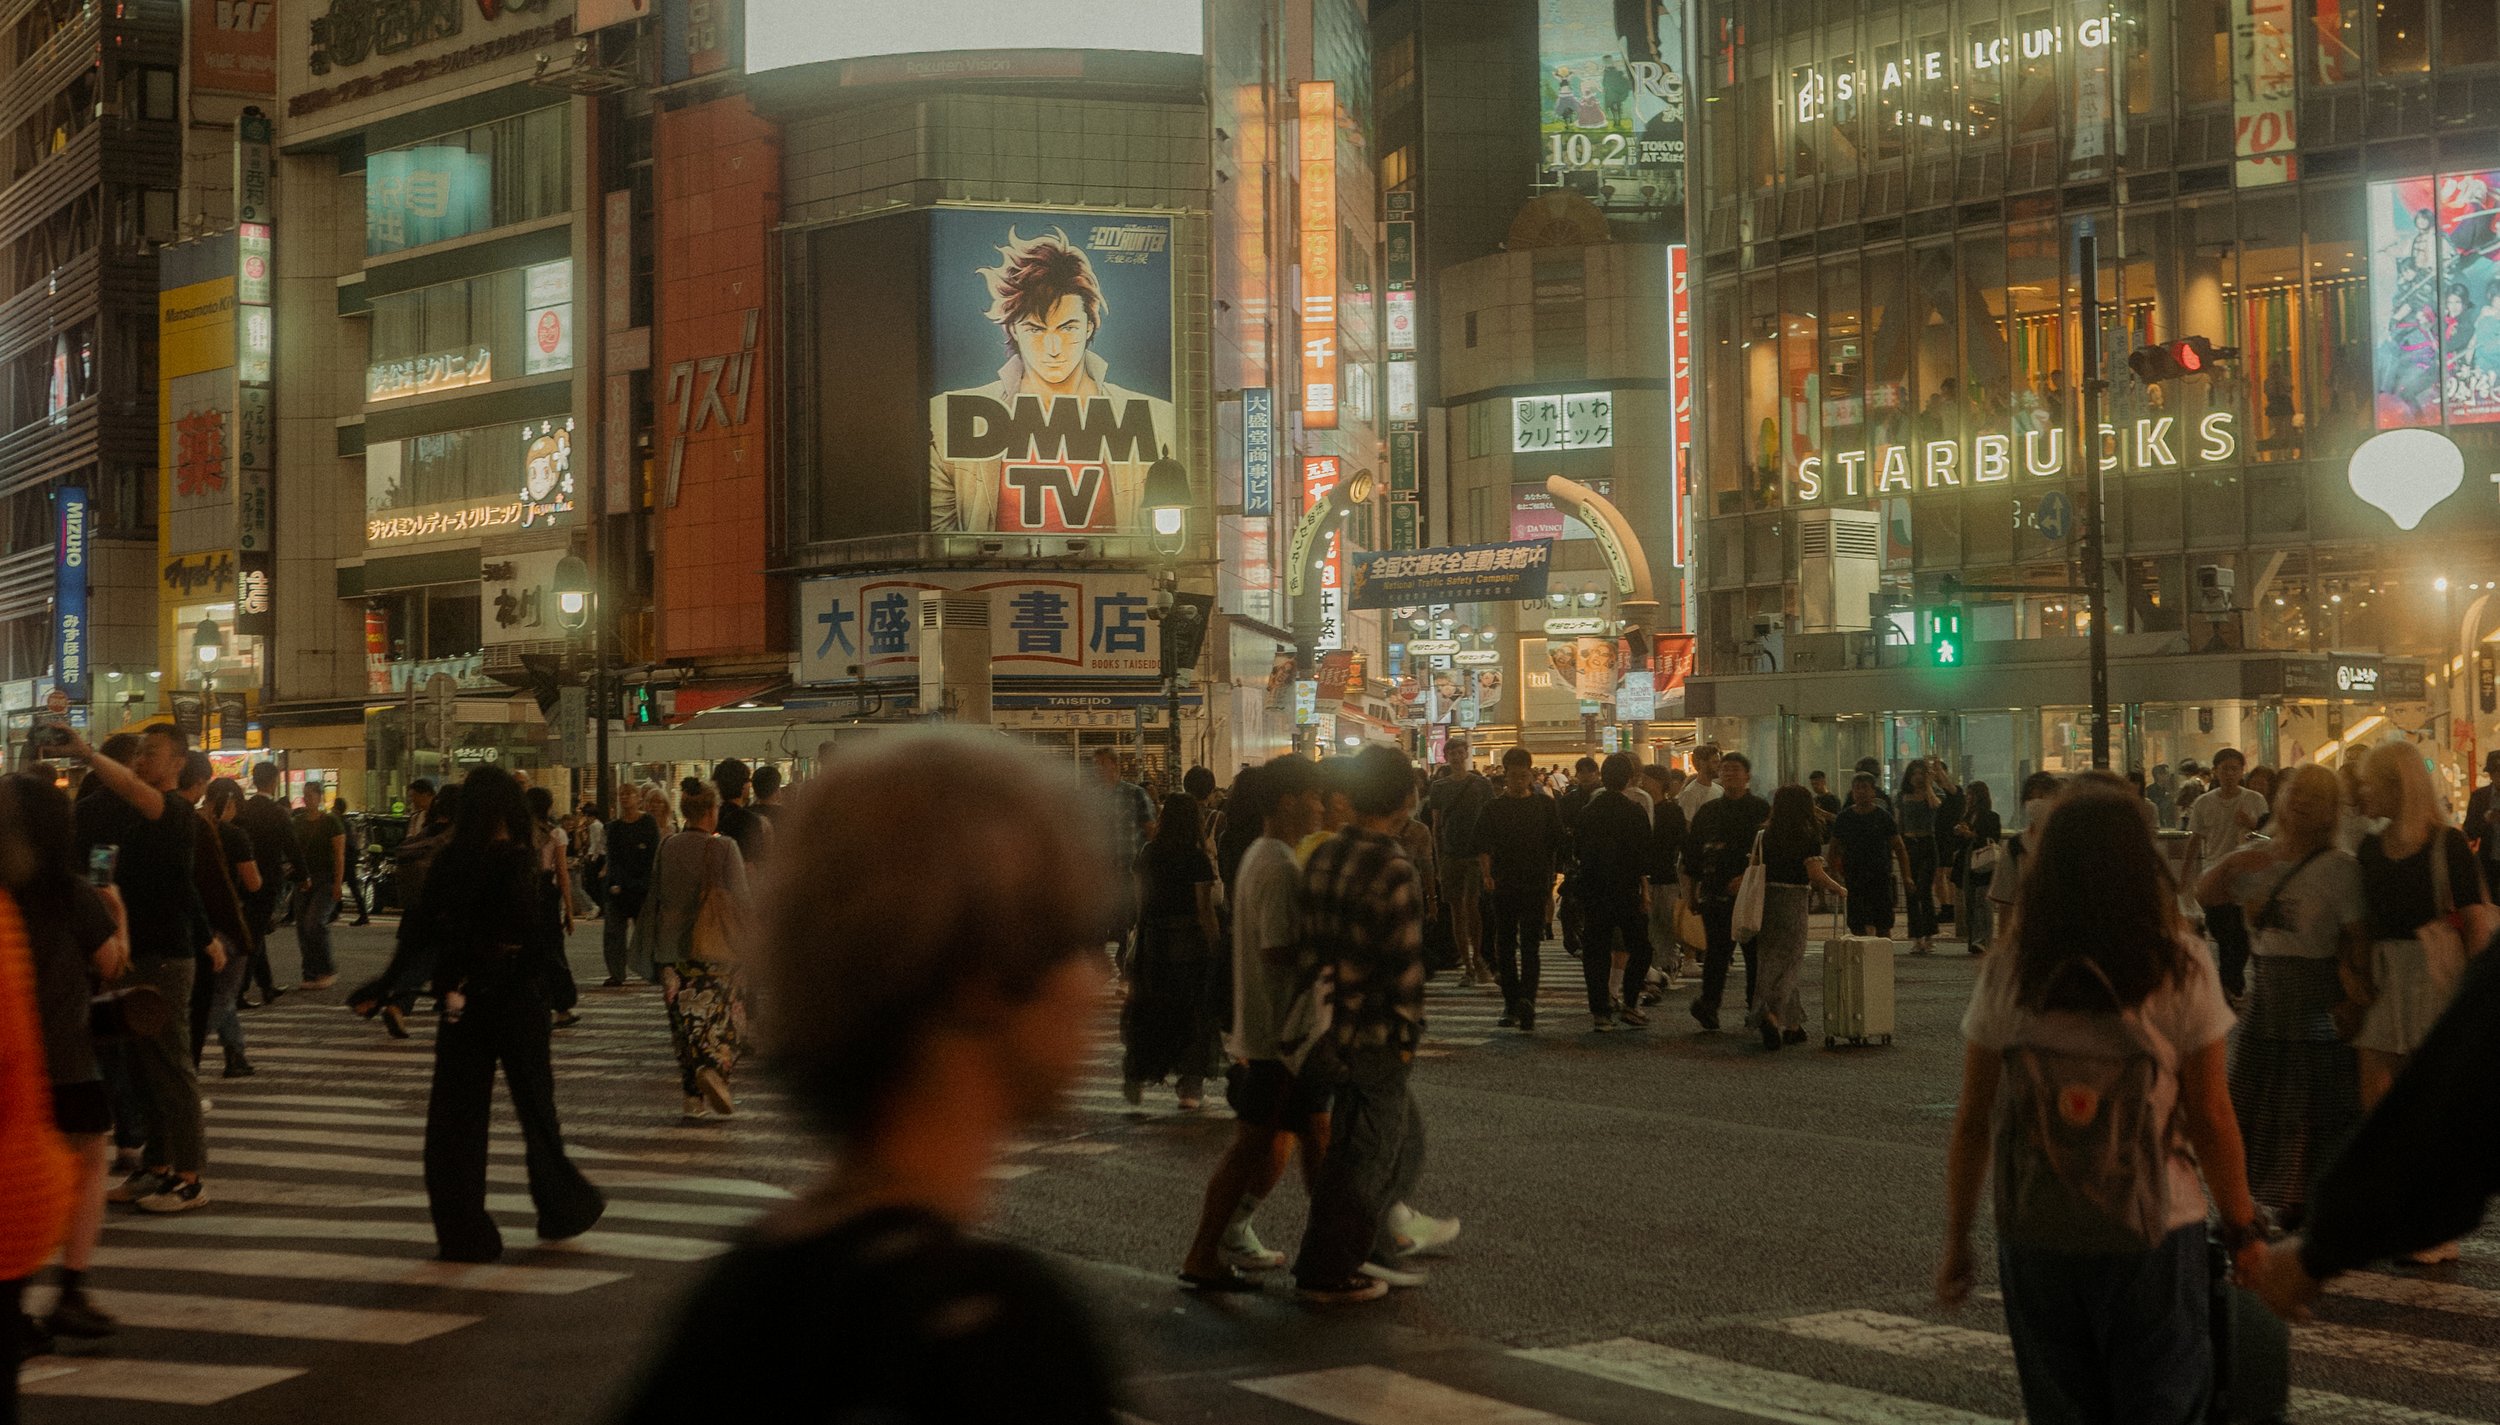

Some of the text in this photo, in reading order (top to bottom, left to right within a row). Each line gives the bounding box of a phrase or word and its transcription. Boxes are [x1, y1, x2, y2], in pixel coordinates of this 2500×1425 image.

[907, 57, 1010, 74] Rakuten Vision
[1549, 133, 1626, 167] 10.2
[1626, 136, 1638, 166] WED
[1640, 141, 1684, 151] TOKYO
[1303, 90, 1335, 412] クスリのことなら 三千里
[1389, 282, 1402, 290] 4F
[166, 303, 219, 322] Matsumoto
[256, 405, 267, 445] フルーツ
[664, 308, 759, 509] クスリ
[1540, 399, 1609, 422] れいわ
[243, 410, 254, 450] パーラー
[945, 394, 1157, 463] DMM
[1518, 424, 1610, 449] クリニック
[176, 409, 226, 499] 薬
[1248, 396, 1267, 510] 大盛堂商事ビル
[243, 492, 253, 533] フルーツ
[1005, 466, 1102, 529] TV
[66, 502, 83, 568] MIZUHO
[369, 502, 522, 541] ジャスミンレディースクリニック
[1527, 524, 1539, 532] DA
[1286, 501, 1325, 590] 渋谷センター街
[1370, 545, 1547, 579] 全国交通安全運動実施中
[1383, 574, 1520, 590] National Traffic Safety Campaign
[816, 591, 1148, 662] 大盛書店
[1547, 622, 1602, 630] 渋谷センター街
[63, 615, 80, 684] みずほ銀行
[1092, 660, 1160, 669] BOOKS TAISEIDO
[1048, 697, 1111, 705] TAISEIDO
[1053, 713, 1132, 725] 大盛堂書店
